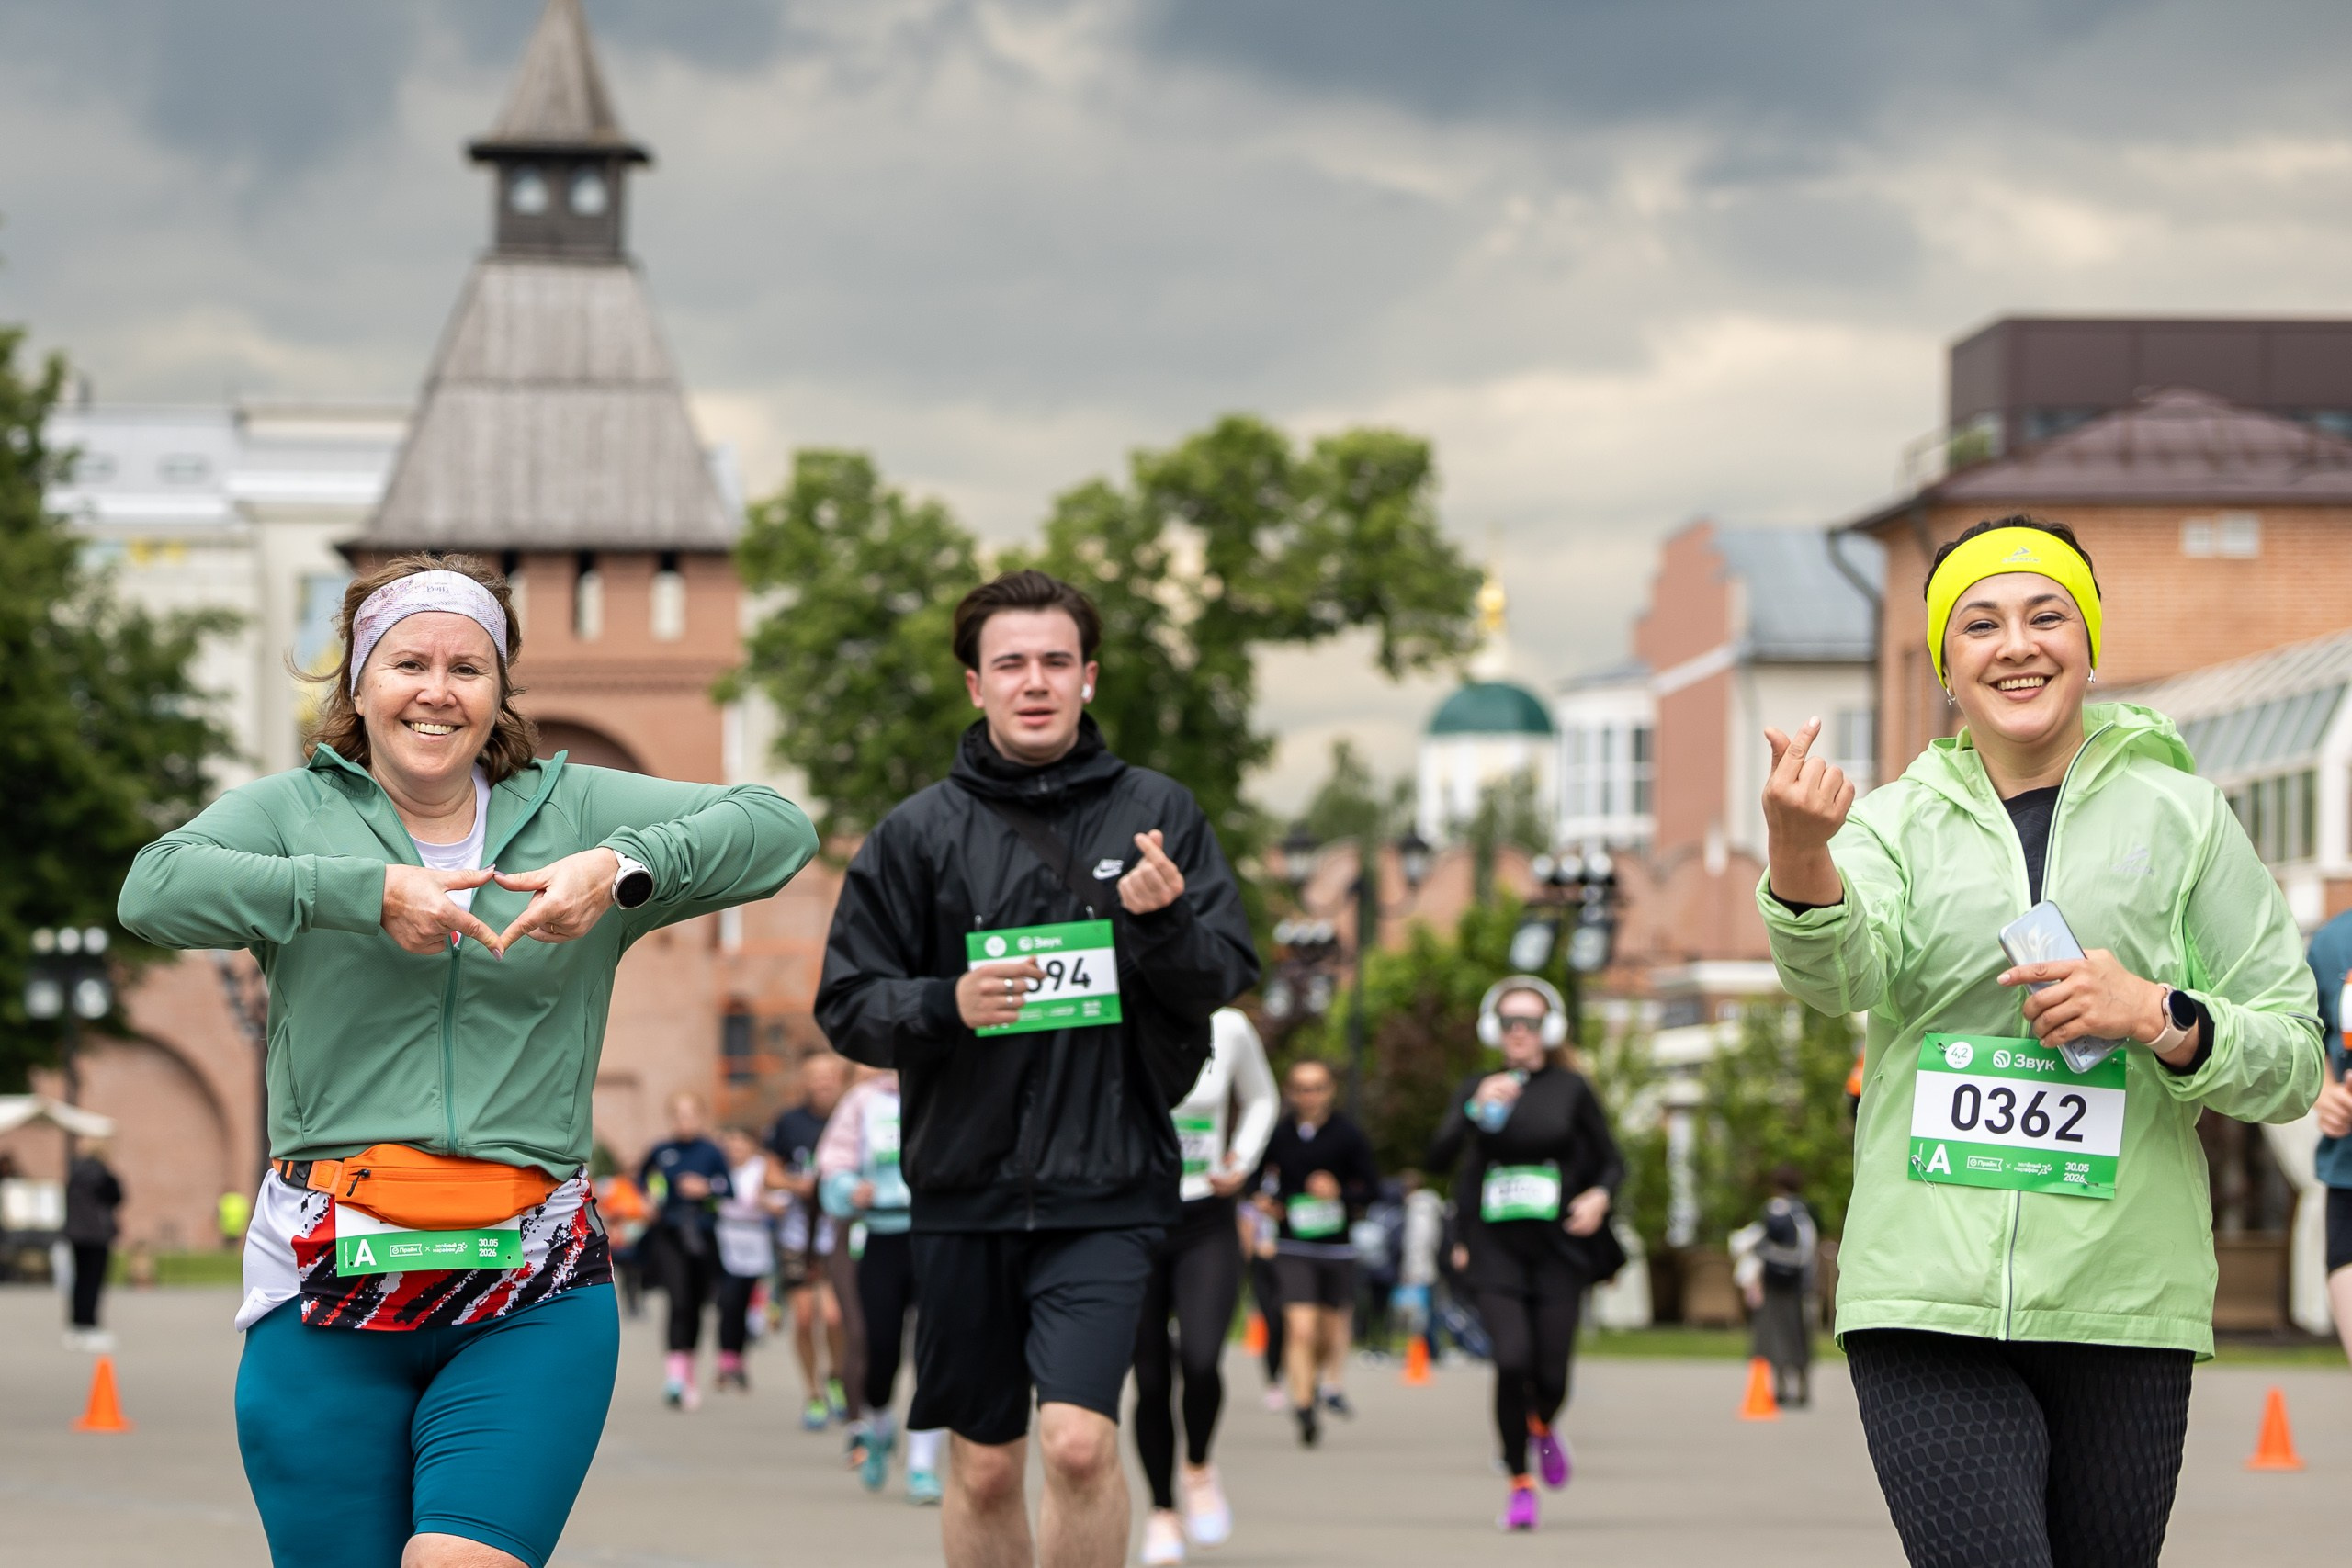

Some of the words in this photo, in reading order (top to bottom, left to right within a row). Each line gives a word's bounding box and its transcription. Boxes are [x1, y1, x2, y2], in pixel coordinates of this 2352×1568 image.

[1951, 1047, 1969, 1059] 4,2
[2013, 1054, 2055, 1072] Звук
[1951, 1084, 2087, 1143] 0362
[2064, 1162, 2090, 1173] 30.05
[2063, 1172, 2086, 1183] 2026
[478, 1238, 499, 1247] 30.05
[478, 1248, 498, 1258] 2026
